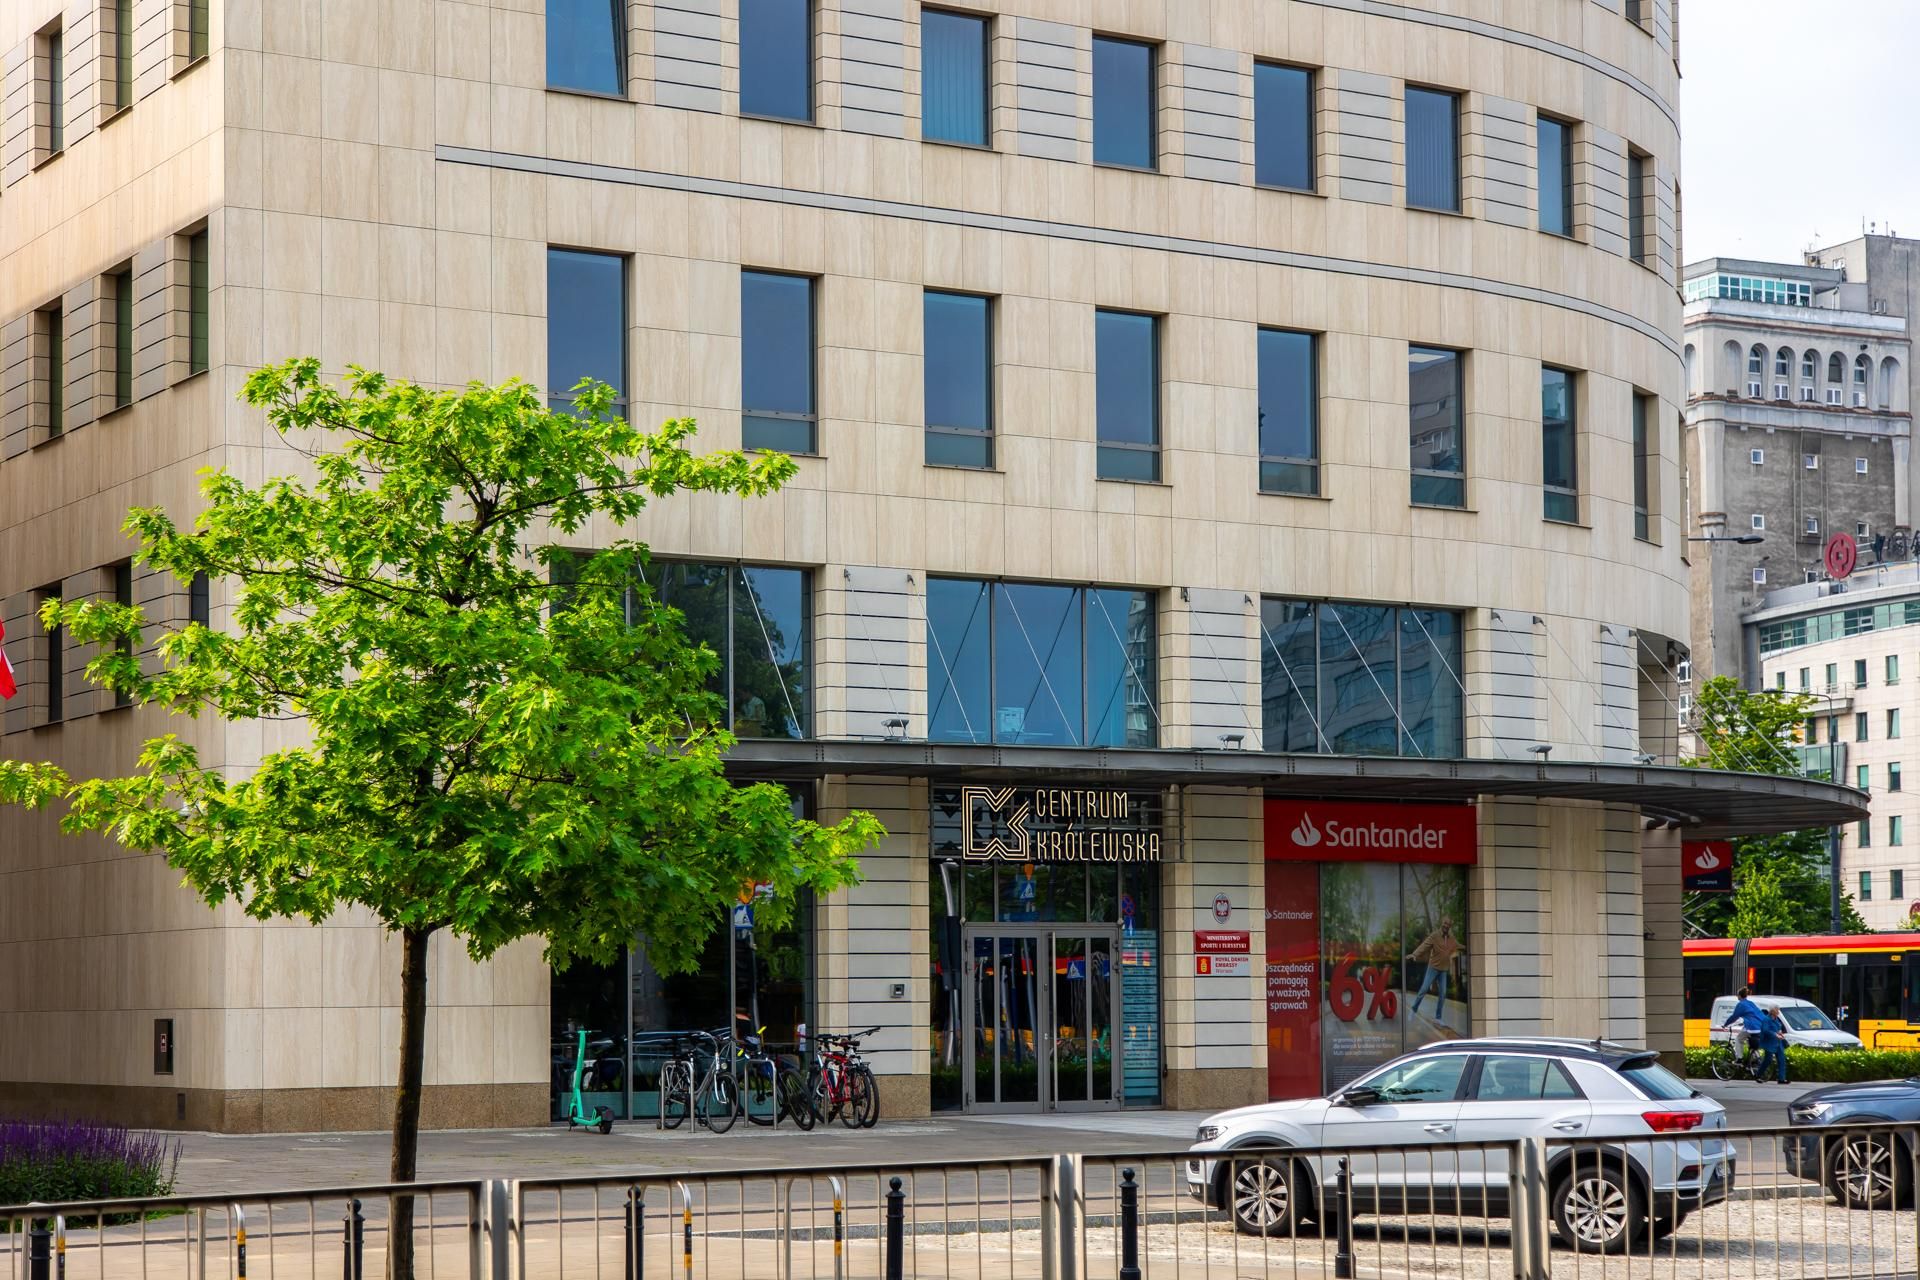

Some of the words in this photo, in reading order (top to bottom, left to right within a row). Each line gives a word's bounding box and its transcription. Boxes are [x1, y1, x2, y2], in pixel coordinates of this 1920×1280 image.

[1035, 789, 1128, 818] CENTRUM
[1037, 823, 1160, 862] KRÓLEWSKA
[1325, 820, 1448, 849] Santander
[1272, 910, 1314, 920] Santander
[1269, 976, 1308, 987] pomagają
[1329, 951, 1398, 1022] 6%
[1267, 990, 1275, 998] w
[1276, 988, 1310, 1000] ważnych
[1270, 1000, 1308, 1012] sprawach
